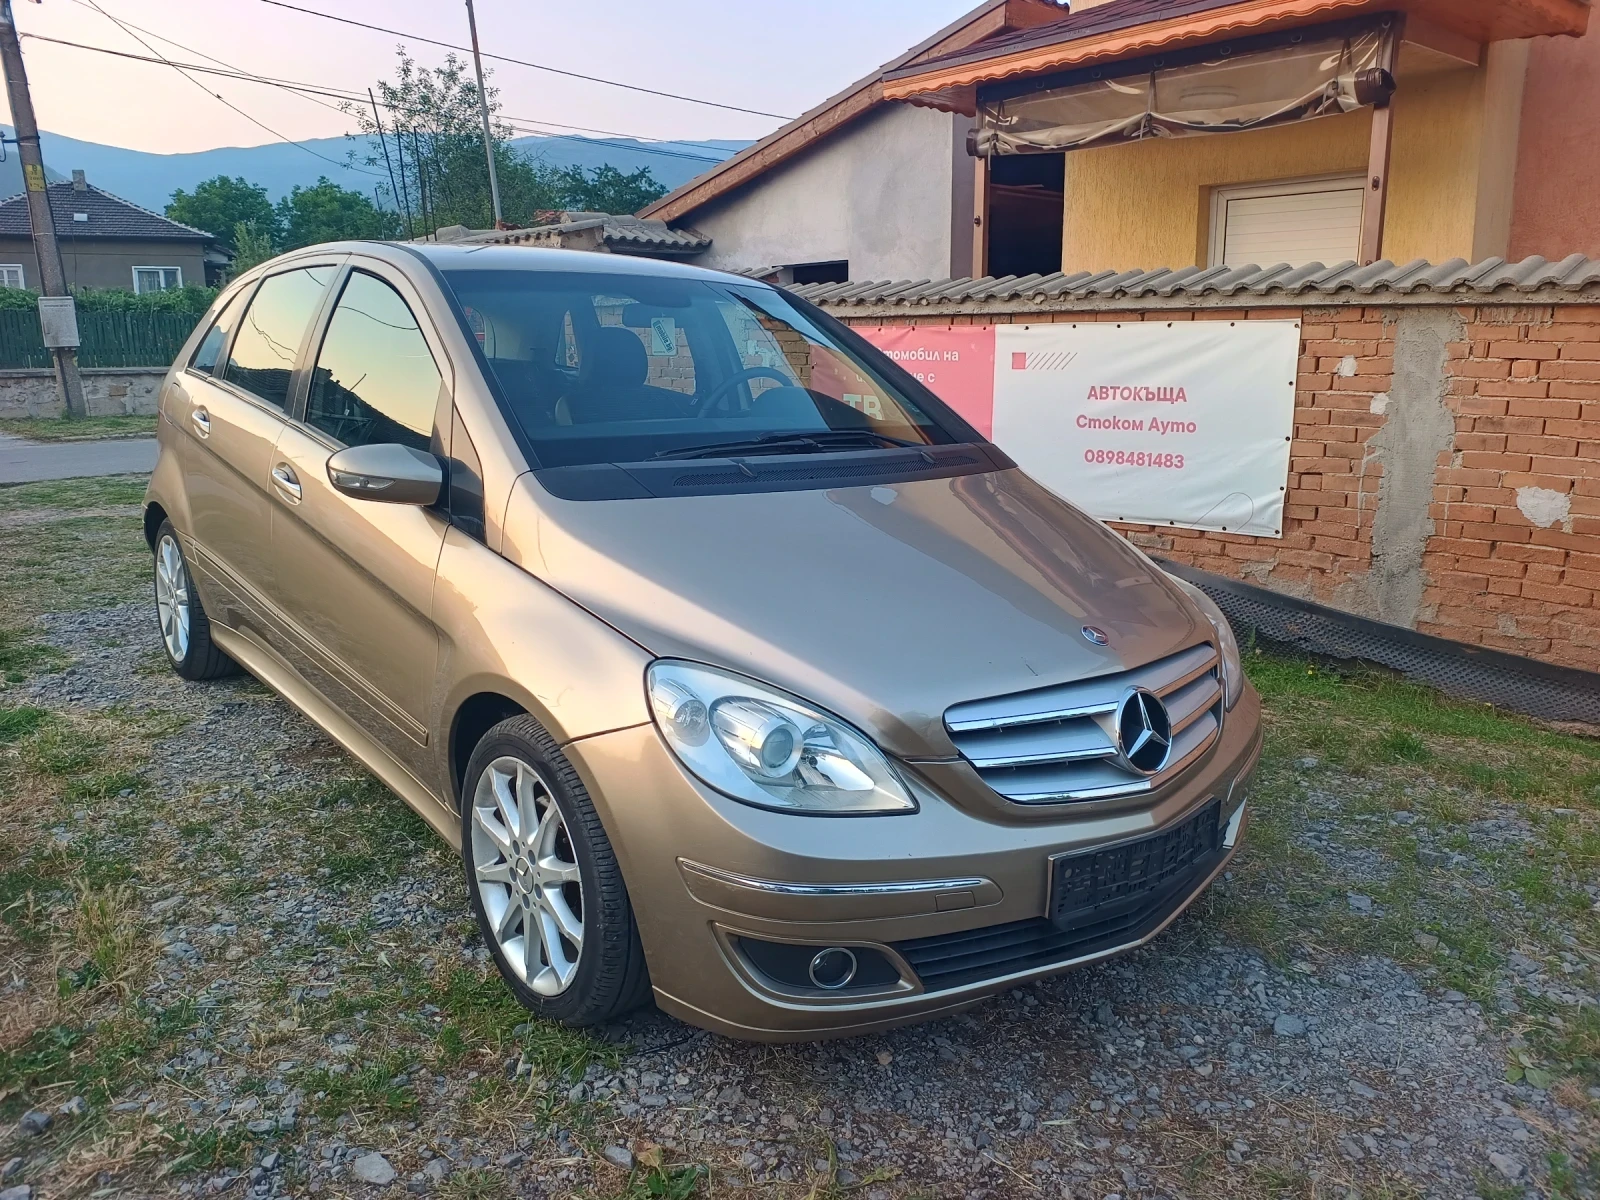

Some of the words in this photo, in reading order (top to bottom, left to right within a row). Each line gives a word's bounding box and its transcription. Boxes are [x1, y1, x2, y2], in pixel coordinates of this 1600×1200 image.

[943, 350, 959, 361] на
[1087, 385, 1188, 404] АВТОКЪЩА
[1076, 414, 1144, 431] Стоком
[1147, 416, 1197, 435] Ауто
[1084, 449, 1185, 469] 0898481483
